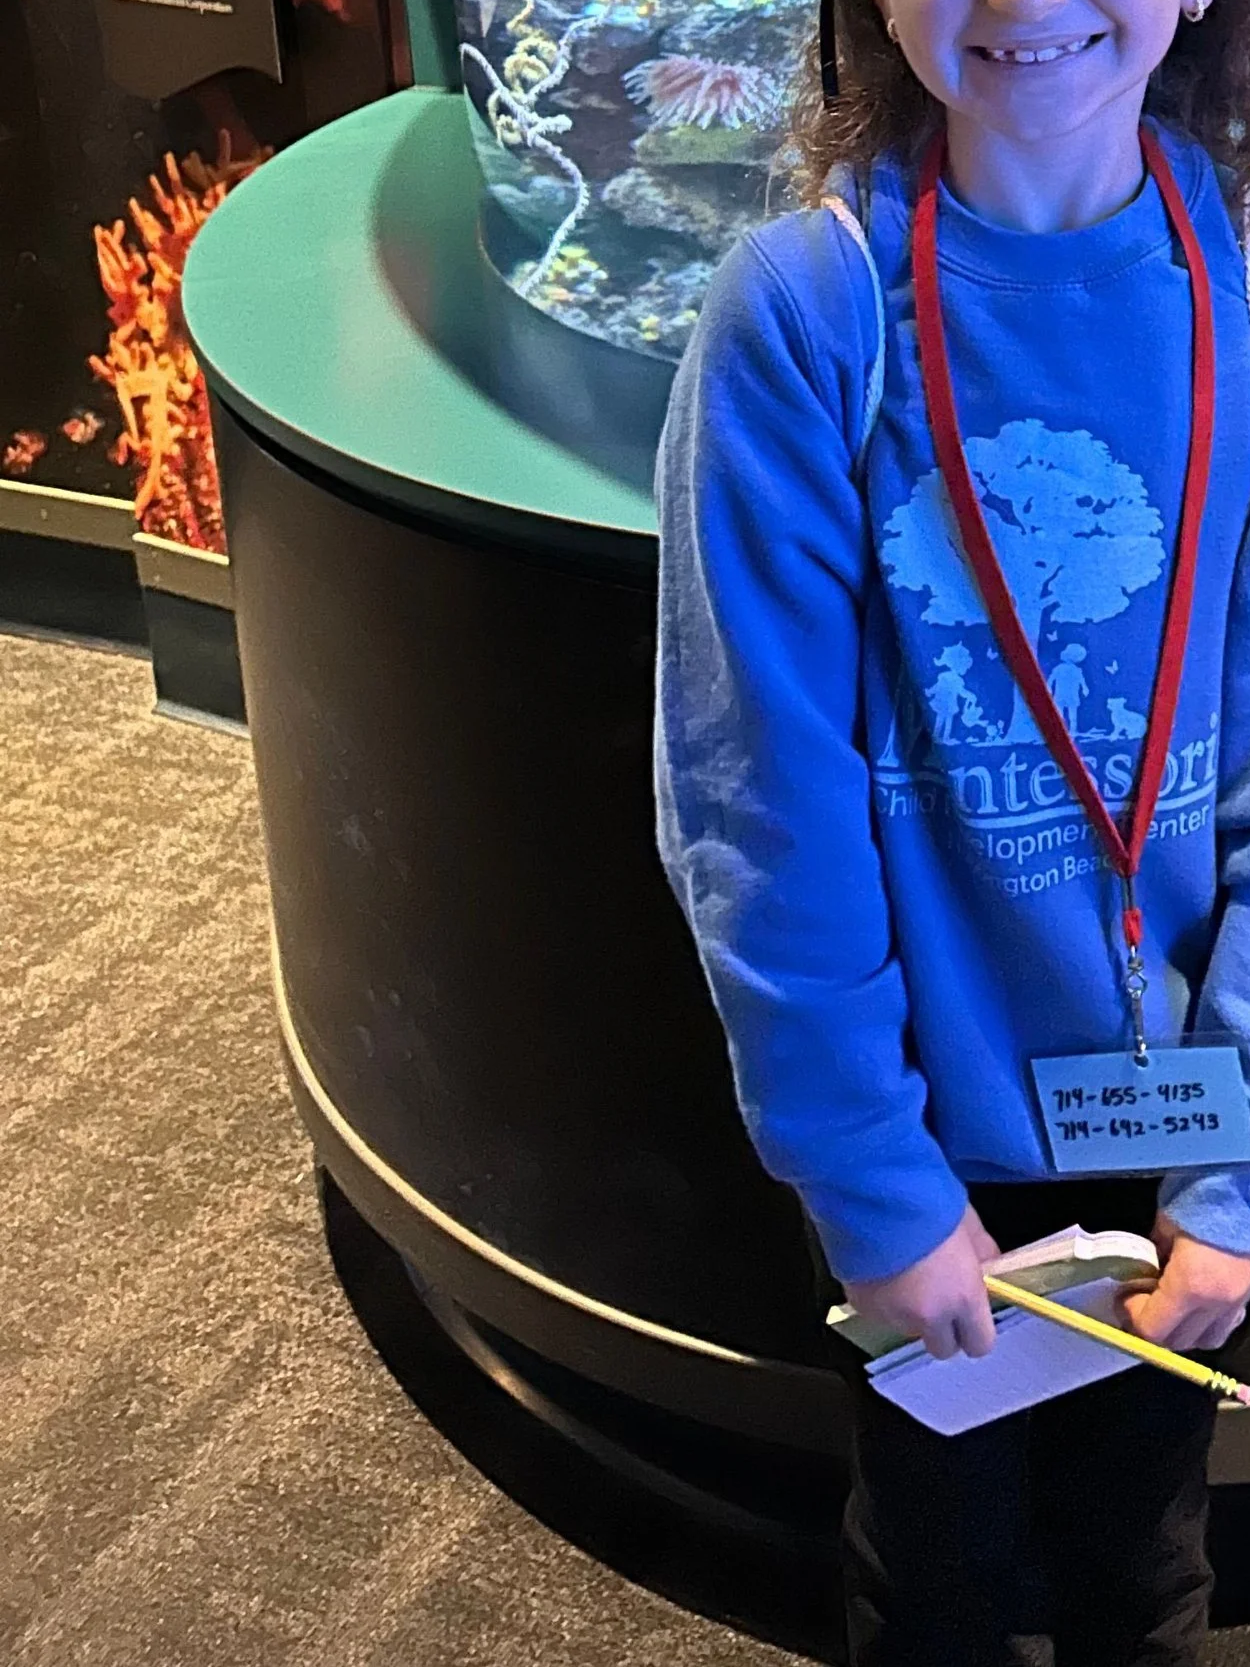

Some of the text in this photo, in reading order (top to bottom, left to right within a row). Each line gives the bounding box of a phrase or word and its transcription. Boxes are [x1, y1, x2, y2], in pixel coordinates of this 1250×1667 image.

[948, 712, 1217, 815] ntesri
[1146, 803, 1211, 840] enter
[1063, 854, 1112, 881] Beac
